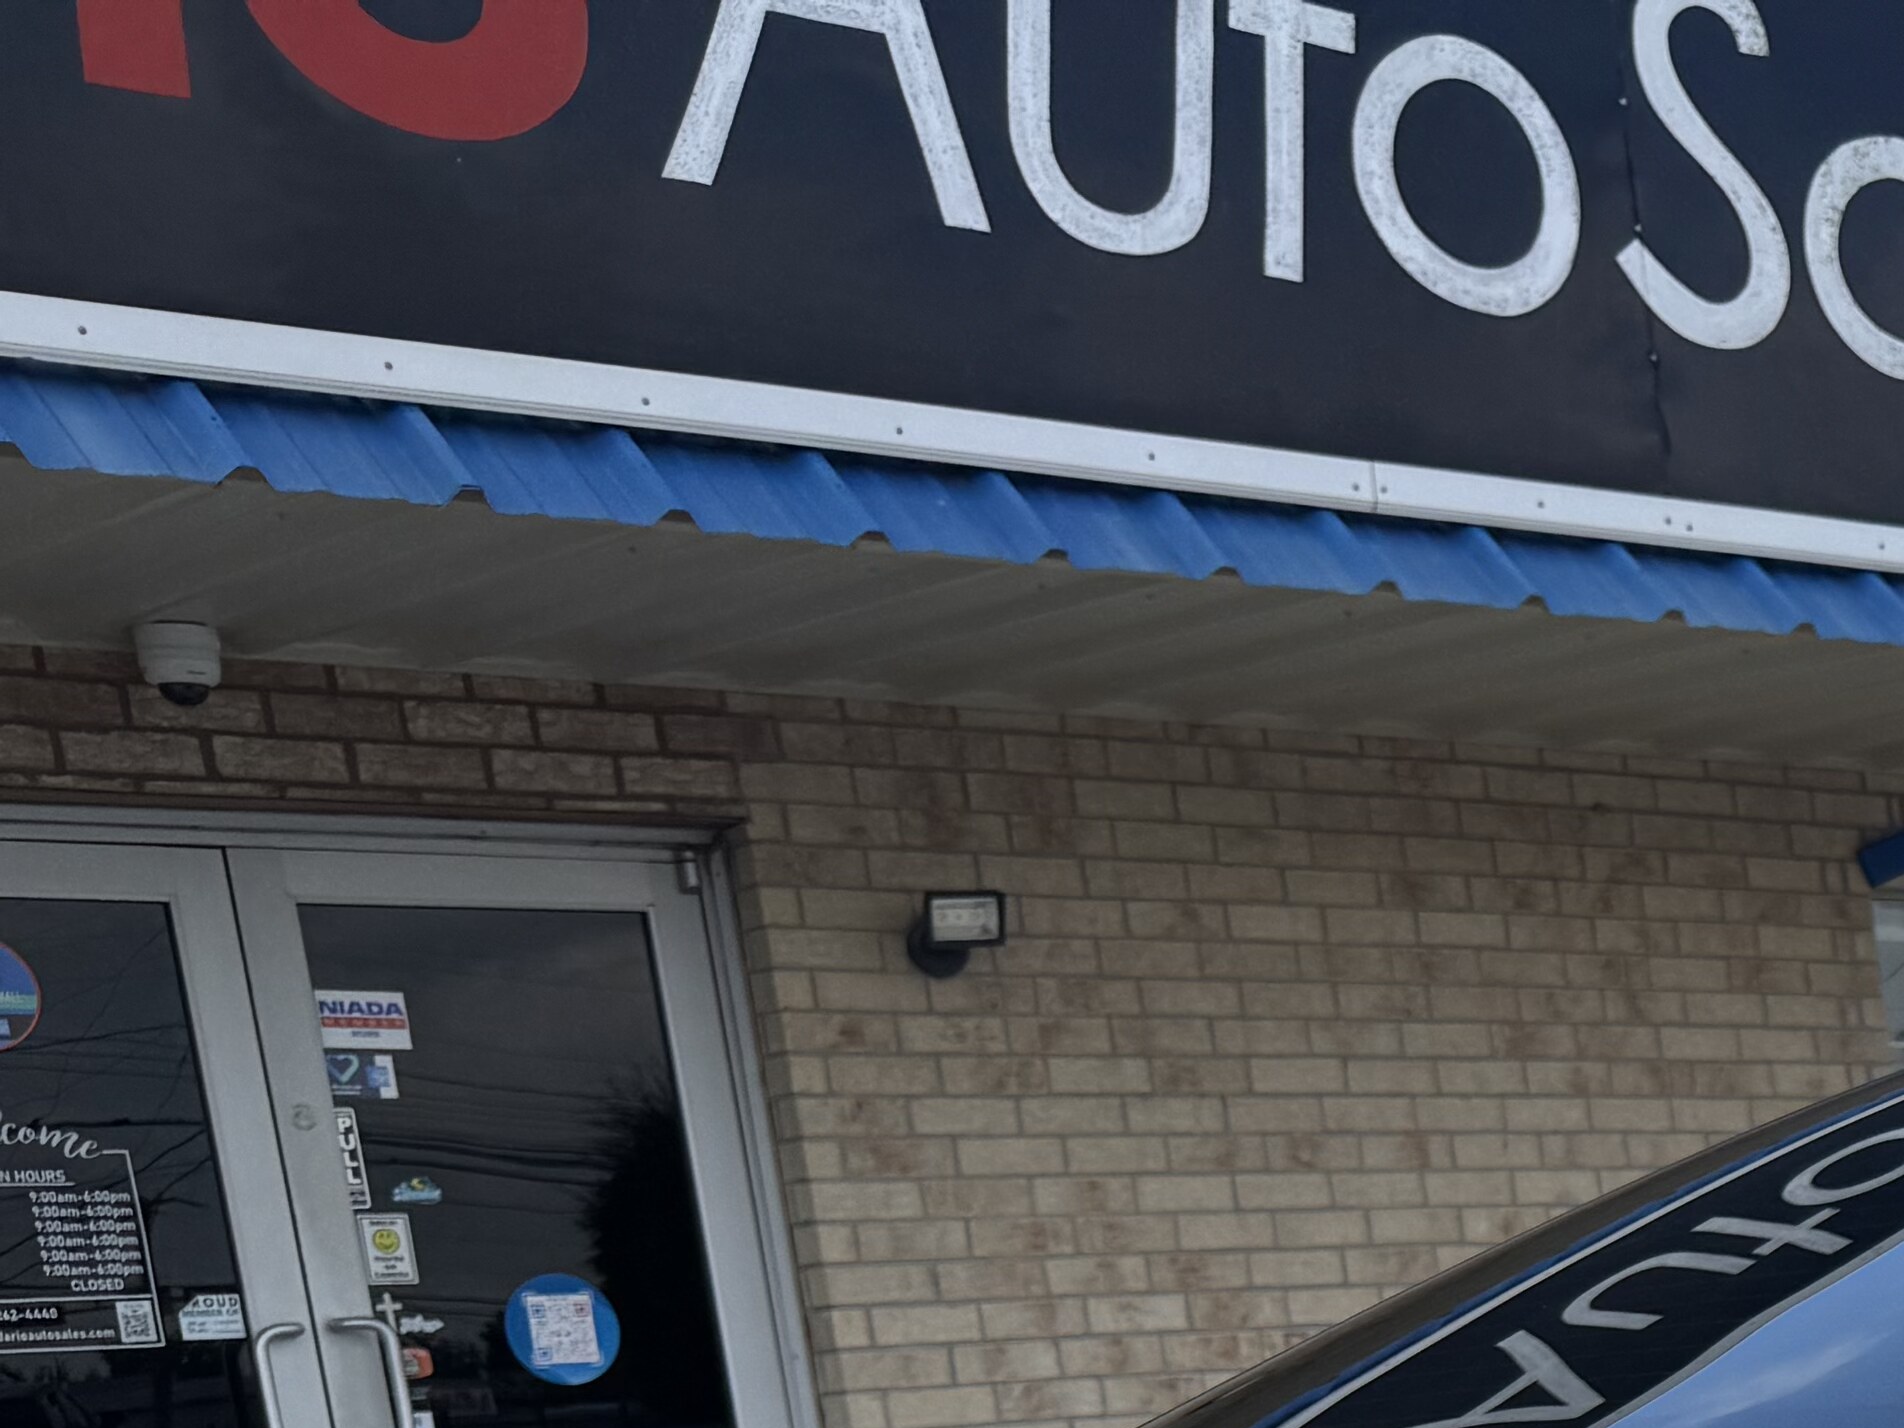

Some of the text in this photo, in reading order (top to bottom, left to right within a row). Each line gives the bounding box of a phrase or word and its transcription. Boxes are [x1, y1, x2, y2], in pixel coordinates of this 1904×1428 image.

[318, 1001, 403, 1016] NIADA
[0, 1110, 101, 1159] come
[337, 1117, 362, 1185] PULL
[14, 1169, 67, 1183] HOURS
[71, 1279, 125, 1292] CLOSED
